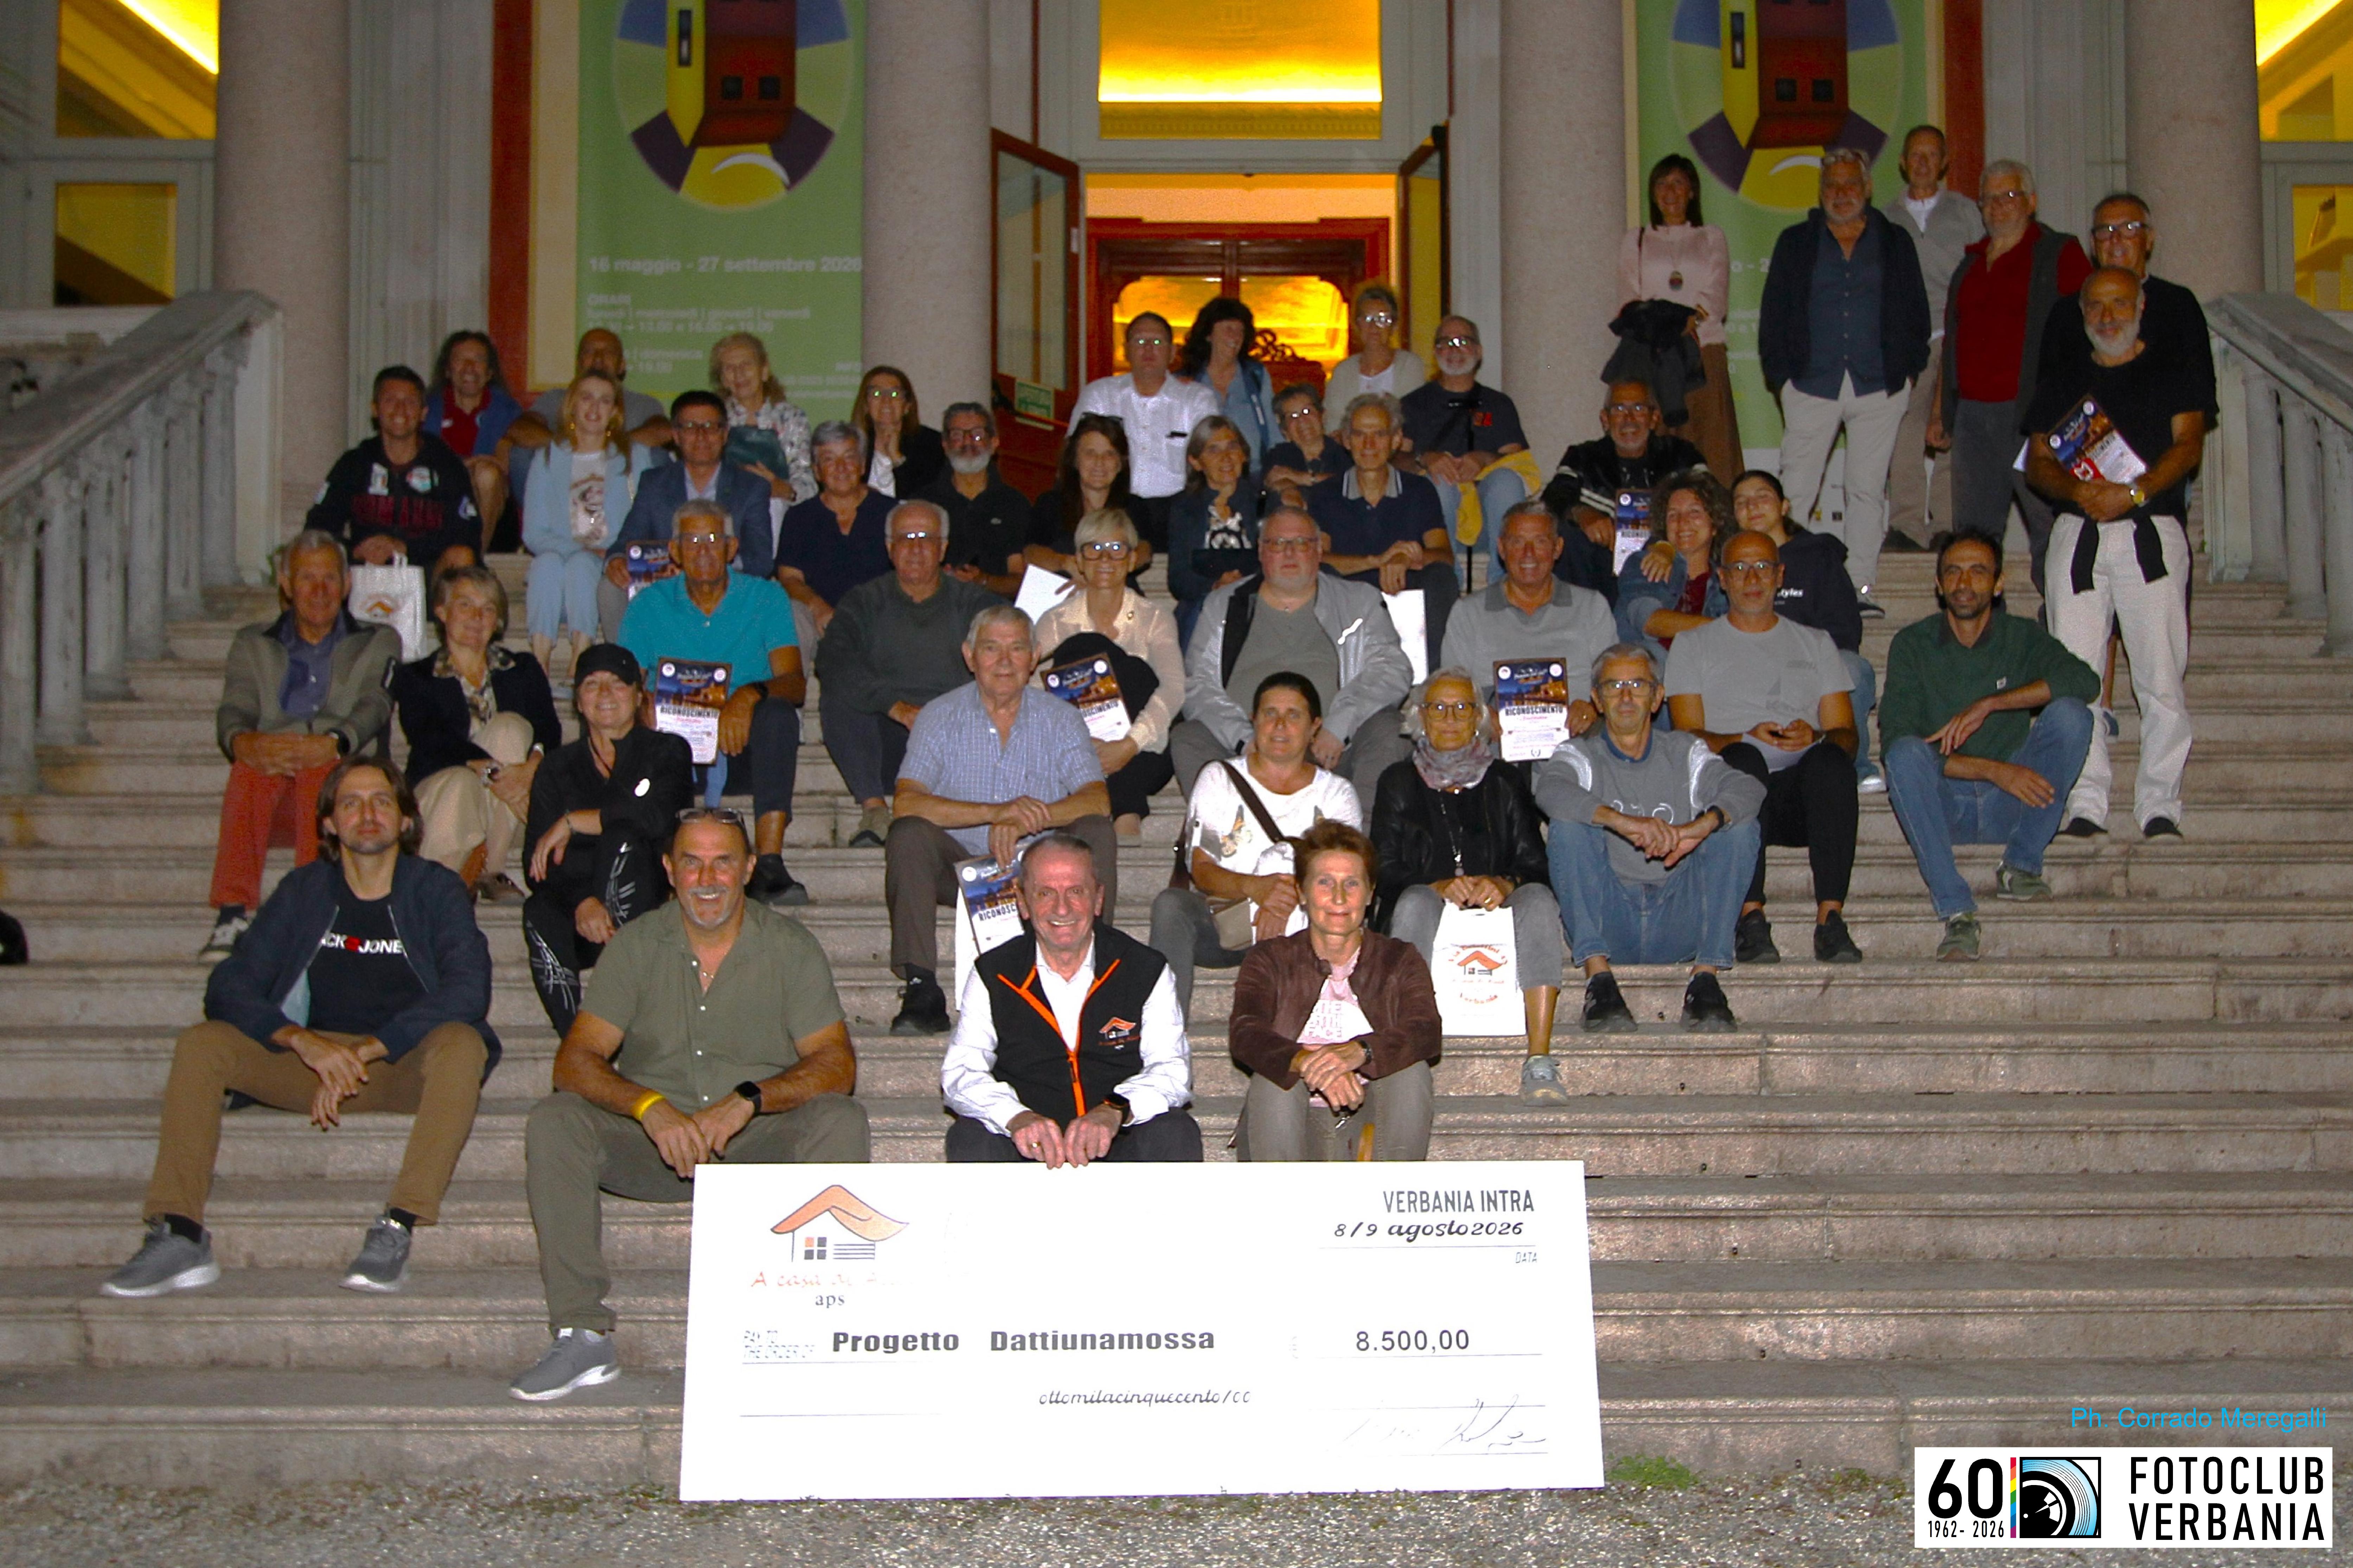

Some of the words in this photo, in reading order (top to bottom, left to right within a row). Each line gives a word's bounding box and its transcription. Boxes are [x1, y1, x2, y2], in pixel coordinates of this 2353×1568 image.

[1505, 706, 1563, 716] RICONOSCIMENTO
[978, 903, 1016, 921] RICONOSC
[358, 939, 403, 954] JONE
[1383, 1190, 1475, 1213] VERBANIA
[1481, 1189, 1535, 1212] INTRA
[815, 1295, 845, 1309] aps
[833, 1332, 959, 1354] Progetto
[991, 1330, 1214, 1351] Dattiunamossa
[1356, 1329, 1469, 1354] 8.500,00
